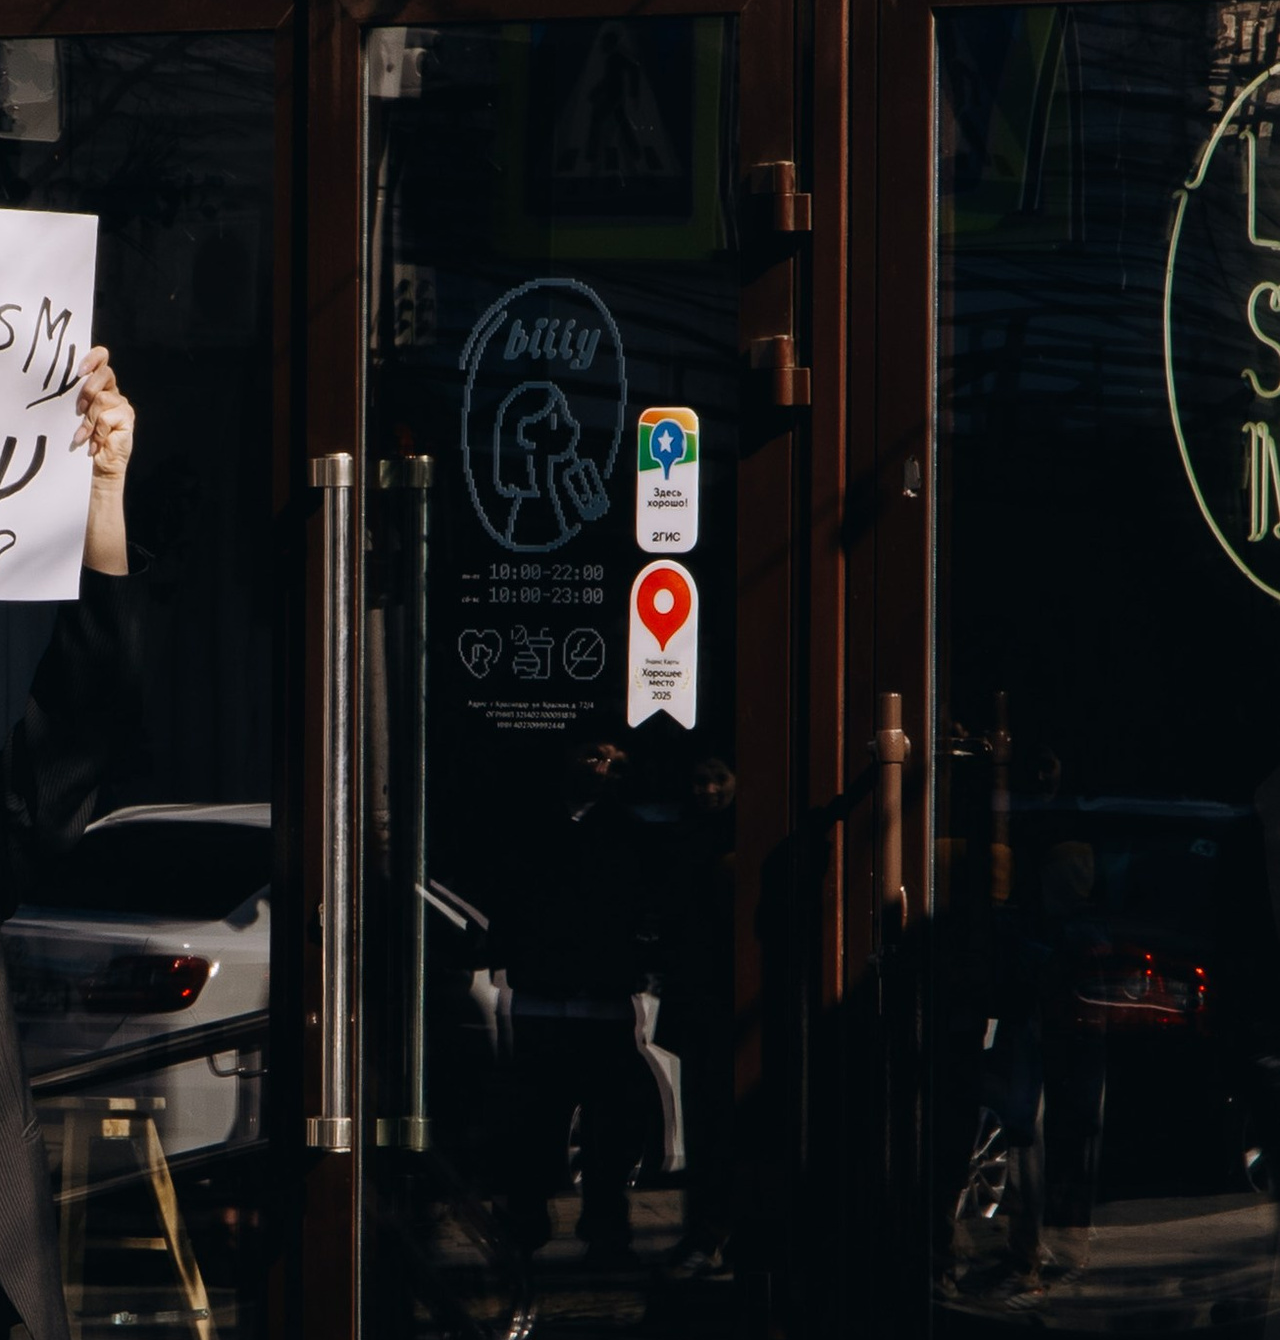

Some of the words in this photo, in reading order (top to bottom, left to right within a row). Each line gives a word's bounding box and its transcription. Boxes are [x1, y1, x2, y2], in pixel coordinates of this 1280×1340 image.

[653, 487, 682, 498] Здесь
[647, 498, 688, 509] хорошо!
[652, 531, 681, 542] 2ГИС
[488, 563, 604, 581] 10:00-22:00
[488, 586, 604, 604] 10:00-23:00
[642, 668, 682, 678] Хорошее
[648, 679, 675, 687] место
[652, 691, 672, 700] 2025
